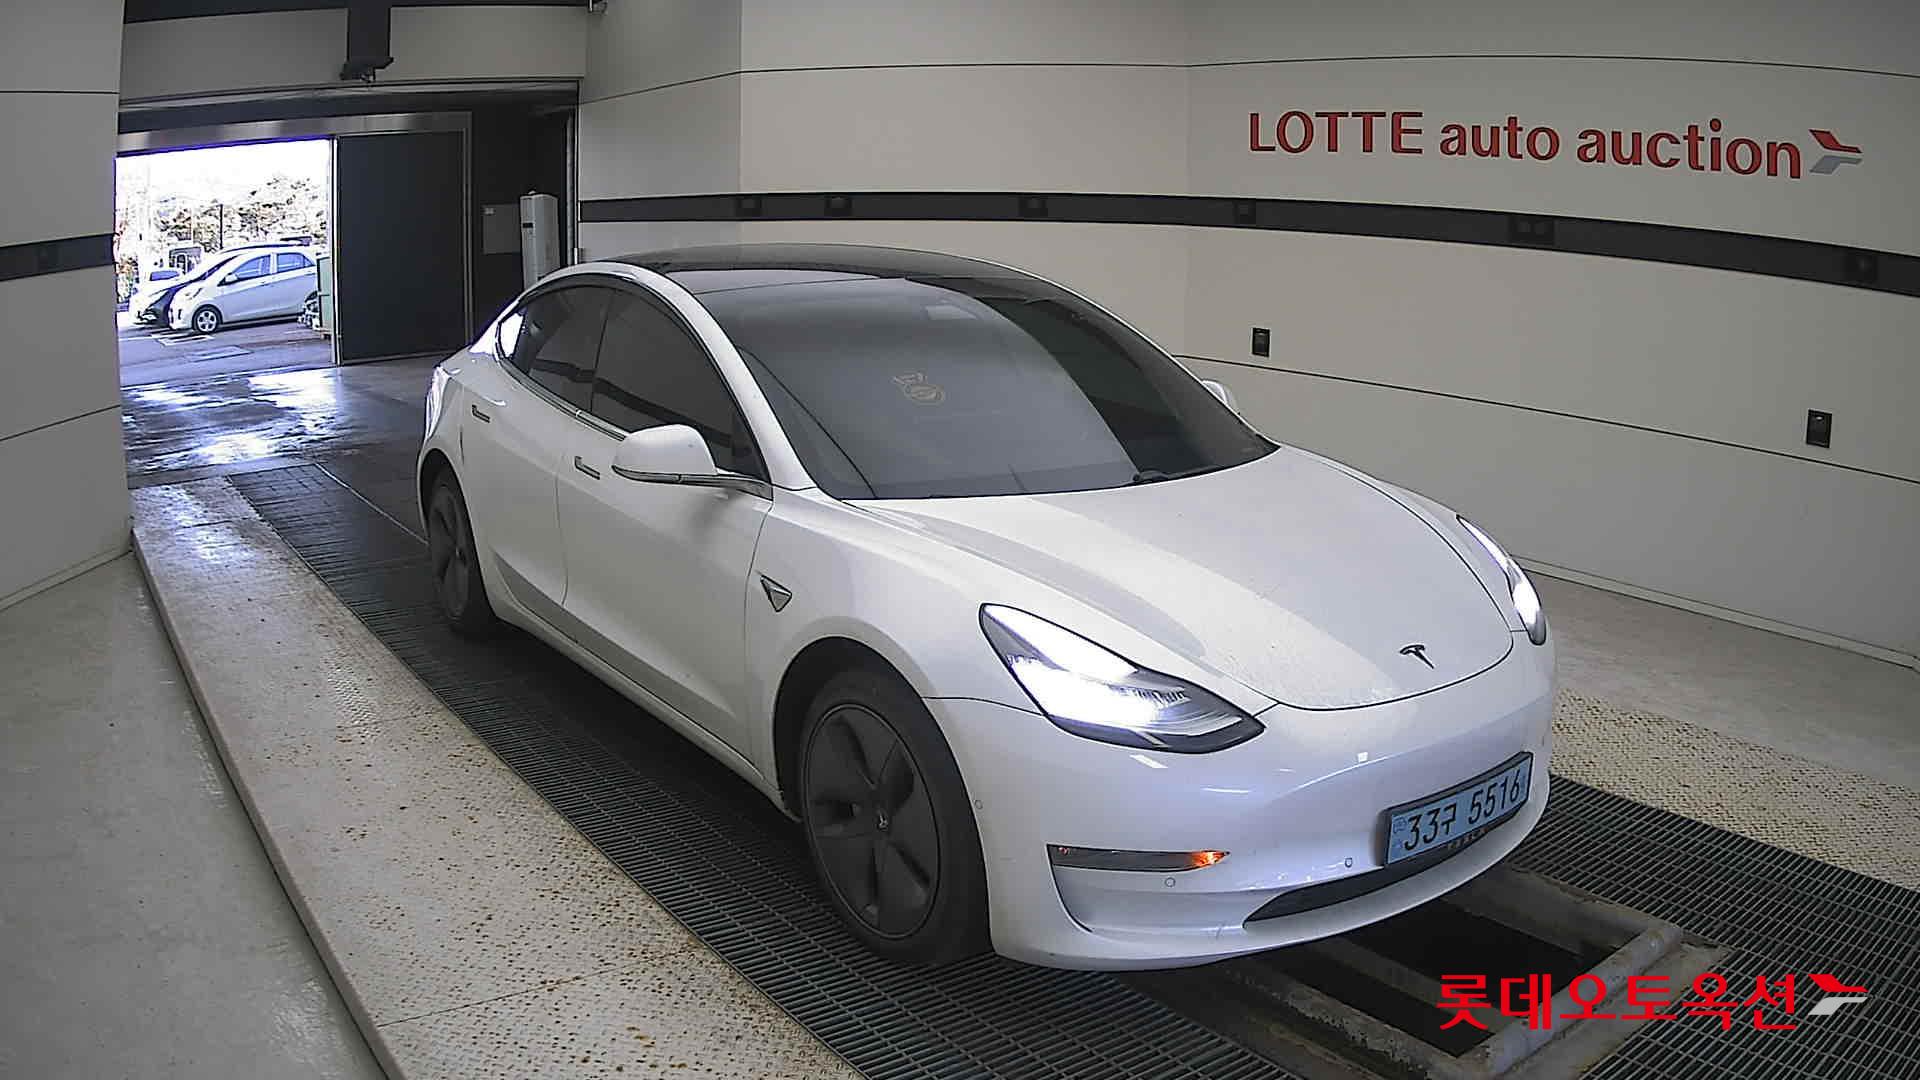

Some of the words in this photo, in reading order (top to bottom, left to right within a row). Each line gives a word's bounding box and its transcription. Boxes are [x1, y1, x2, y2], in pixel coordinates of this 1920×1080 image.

[1249, 111, 1424, 154] LOTTE
[1439, 116, 1560, 161] auto
[1576, 118, 1801, 179] auction
[1404, 802, 1457, 851] 33구
[1468, 769, 1521, 825] 5516
